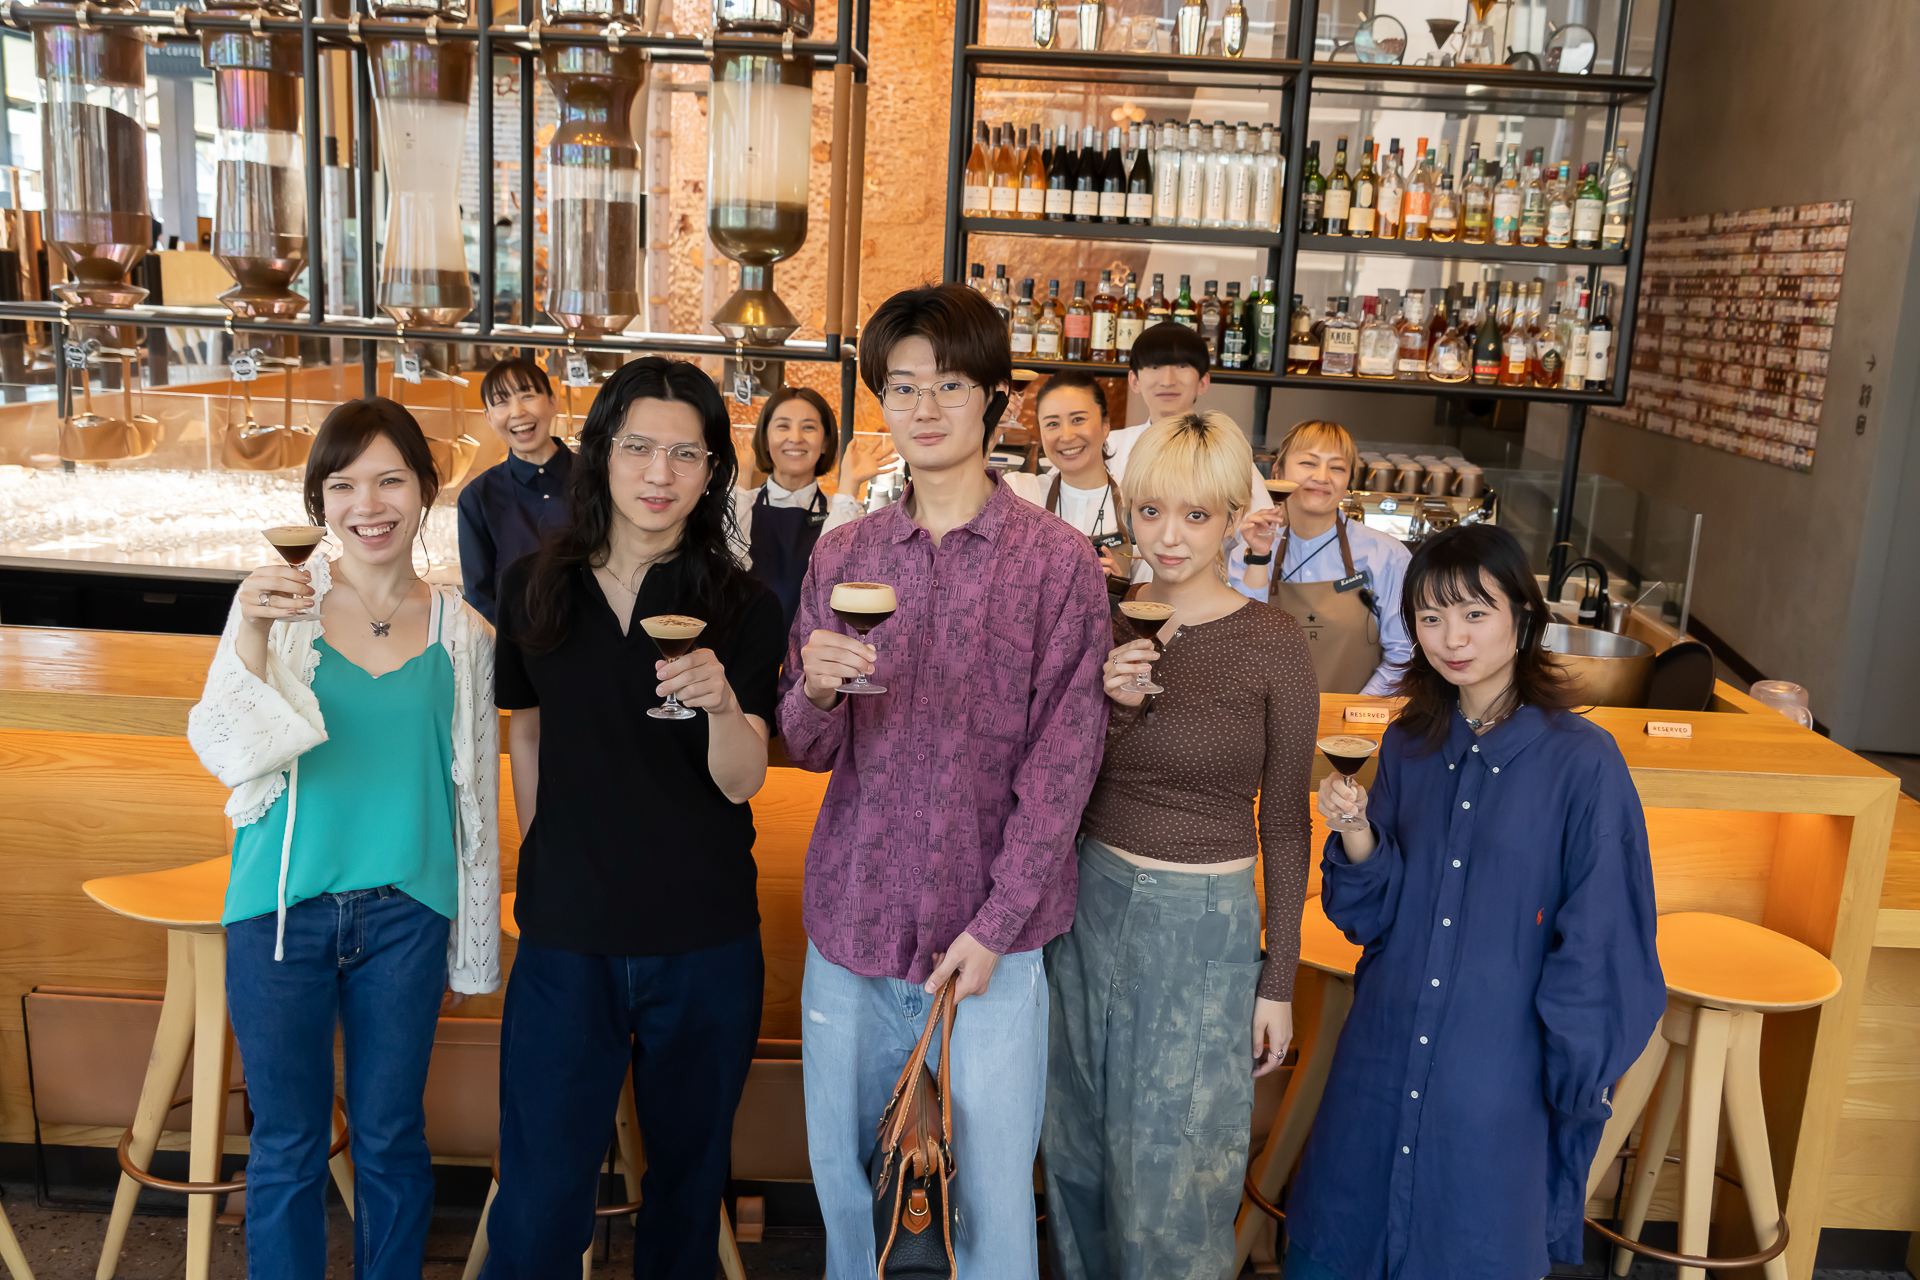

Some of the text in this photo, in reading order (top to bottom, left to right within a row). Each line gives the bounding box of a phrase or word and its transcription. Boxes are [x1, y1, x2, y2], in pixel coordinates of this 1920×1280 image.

[1309, 631, 1318, 641] R
[1350, 711, 1386, 719] RESERVED
[1652, 725, 1688, 733] RESERVED
